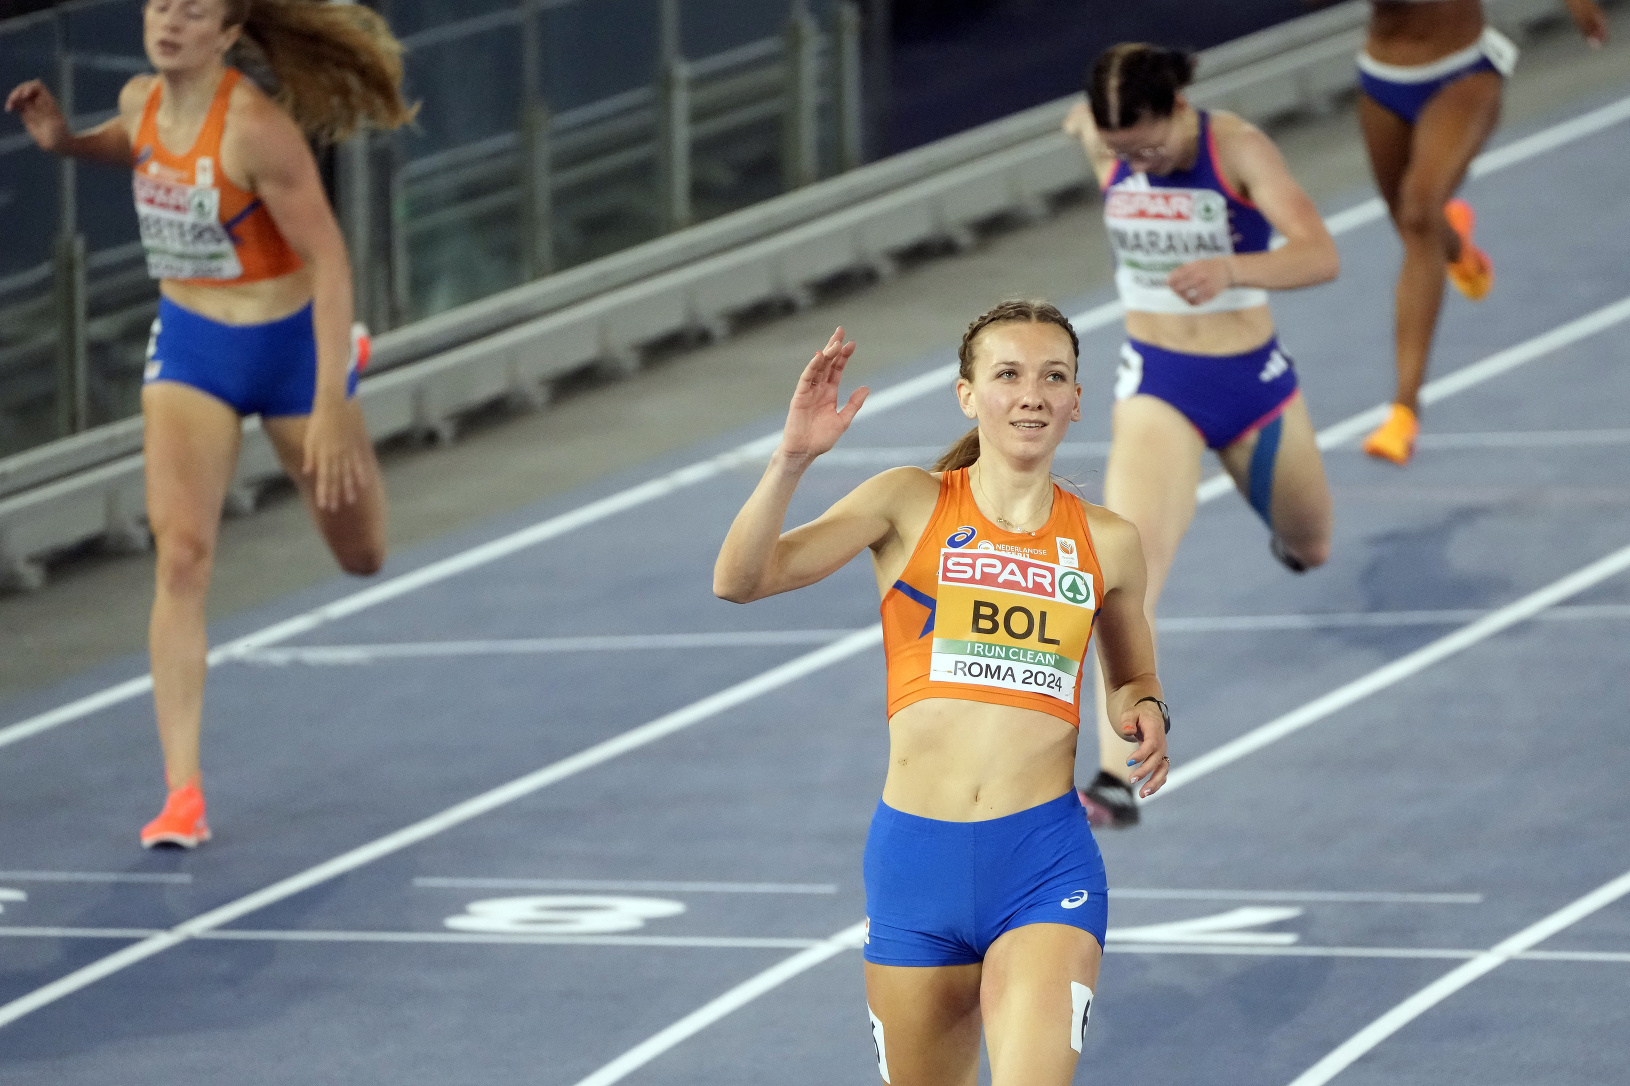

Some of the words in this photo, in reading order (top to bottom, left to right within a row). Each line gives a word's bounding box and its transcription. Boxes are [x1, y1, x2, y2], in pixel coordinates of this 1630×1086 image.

[1108, 192, 1190, 220] SPAR
[995, 543, 1047, 556] NEDERLANDSE
[945, 556, 1053, 593] SPAR
[971, 600, 1061, 646] BOL
[966, 642, 971, 654] I
[974, 643, 1006, 658] RUN
[953, 660, 1017, 683] ROMA
[1021, 669, 1063, 692] 2024
